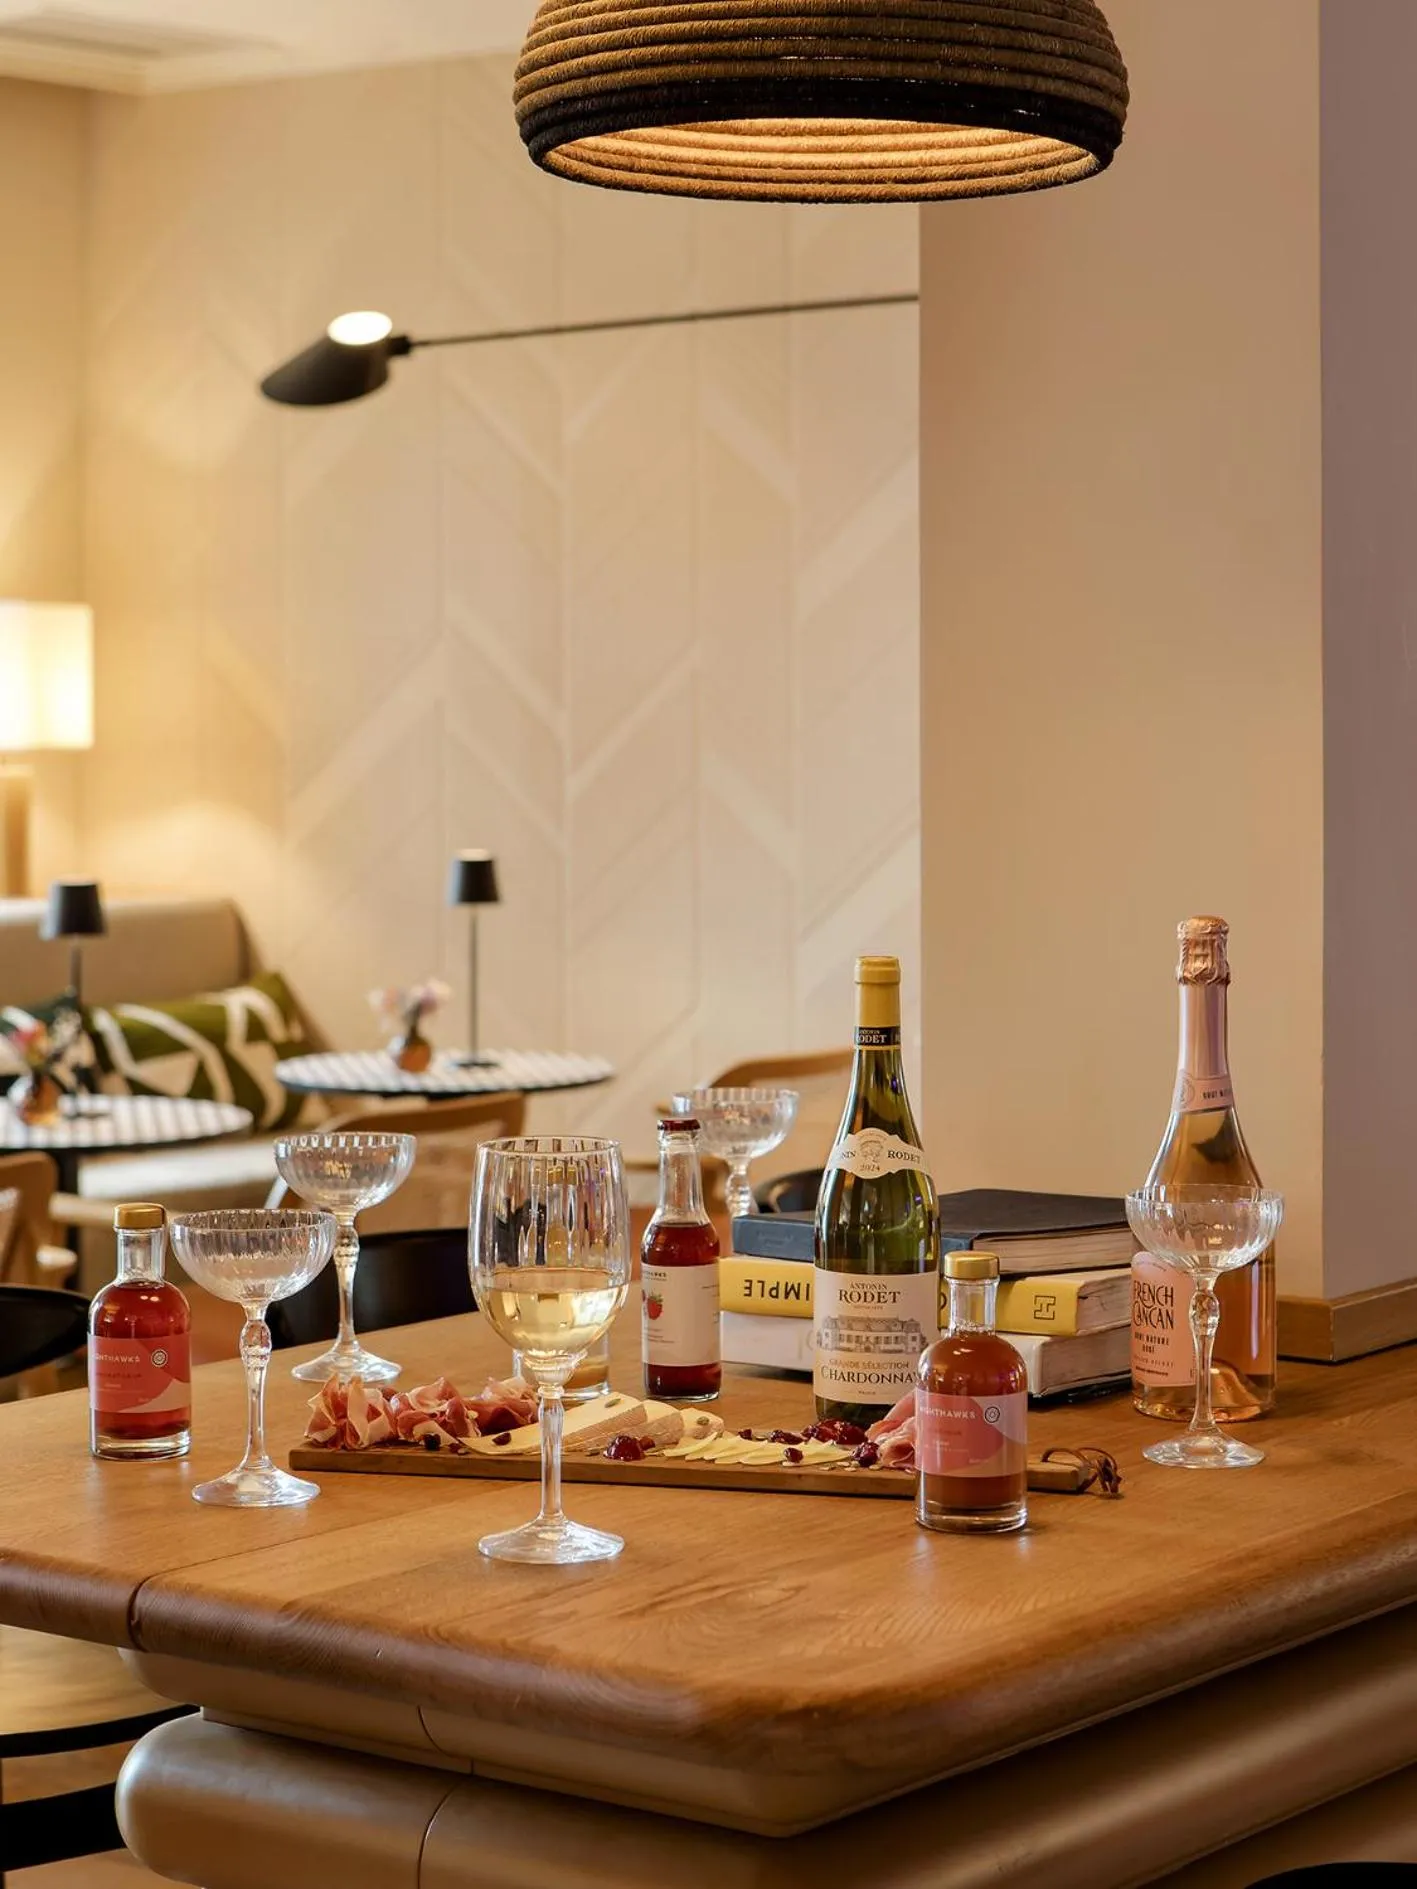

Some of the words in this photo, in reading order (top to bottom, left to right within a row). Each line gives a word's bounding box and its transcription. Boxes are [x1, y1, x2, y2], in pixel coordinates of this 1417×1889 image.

[855, 1034, 887, 1044] ODET
[743, 1278, 811, 1301] IMPLE
[849, 1281, 888, 1290] ANTONIN
[838, 1288, 901, 1304] RODET
[1133, 1279, 1175, 1309] FRENCH
